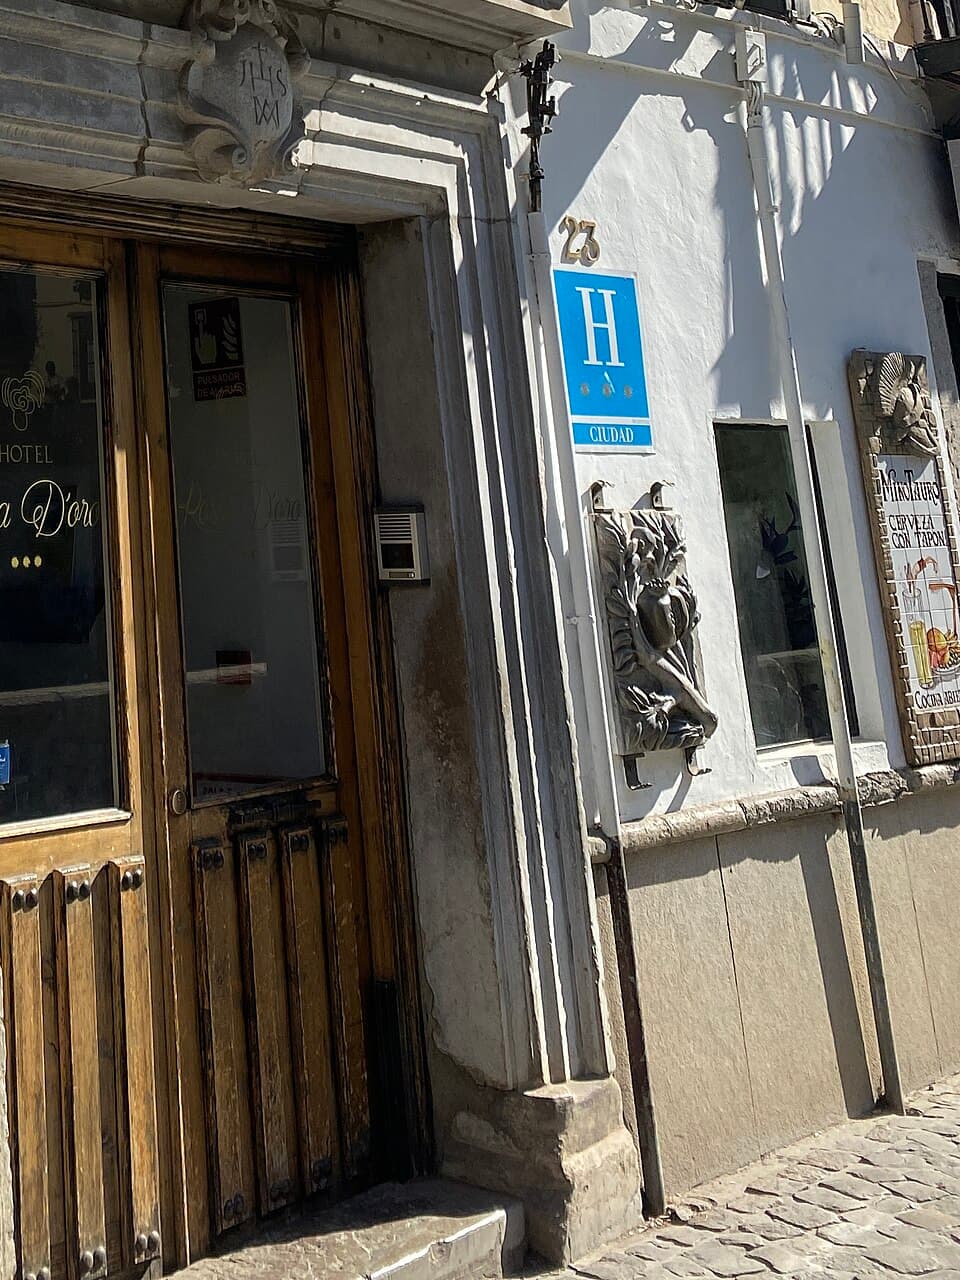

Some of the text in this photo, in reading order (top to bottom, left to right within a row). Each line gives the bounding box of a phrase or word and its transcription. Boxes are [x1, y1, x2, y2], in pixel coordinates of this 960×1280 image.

[575, 286, 625, 367] H
[589, 425, 634, 443] CIUDAD
[888, 514, 935, 531] CERVEZA
[891, 530, 946, 549] CON TAPON
